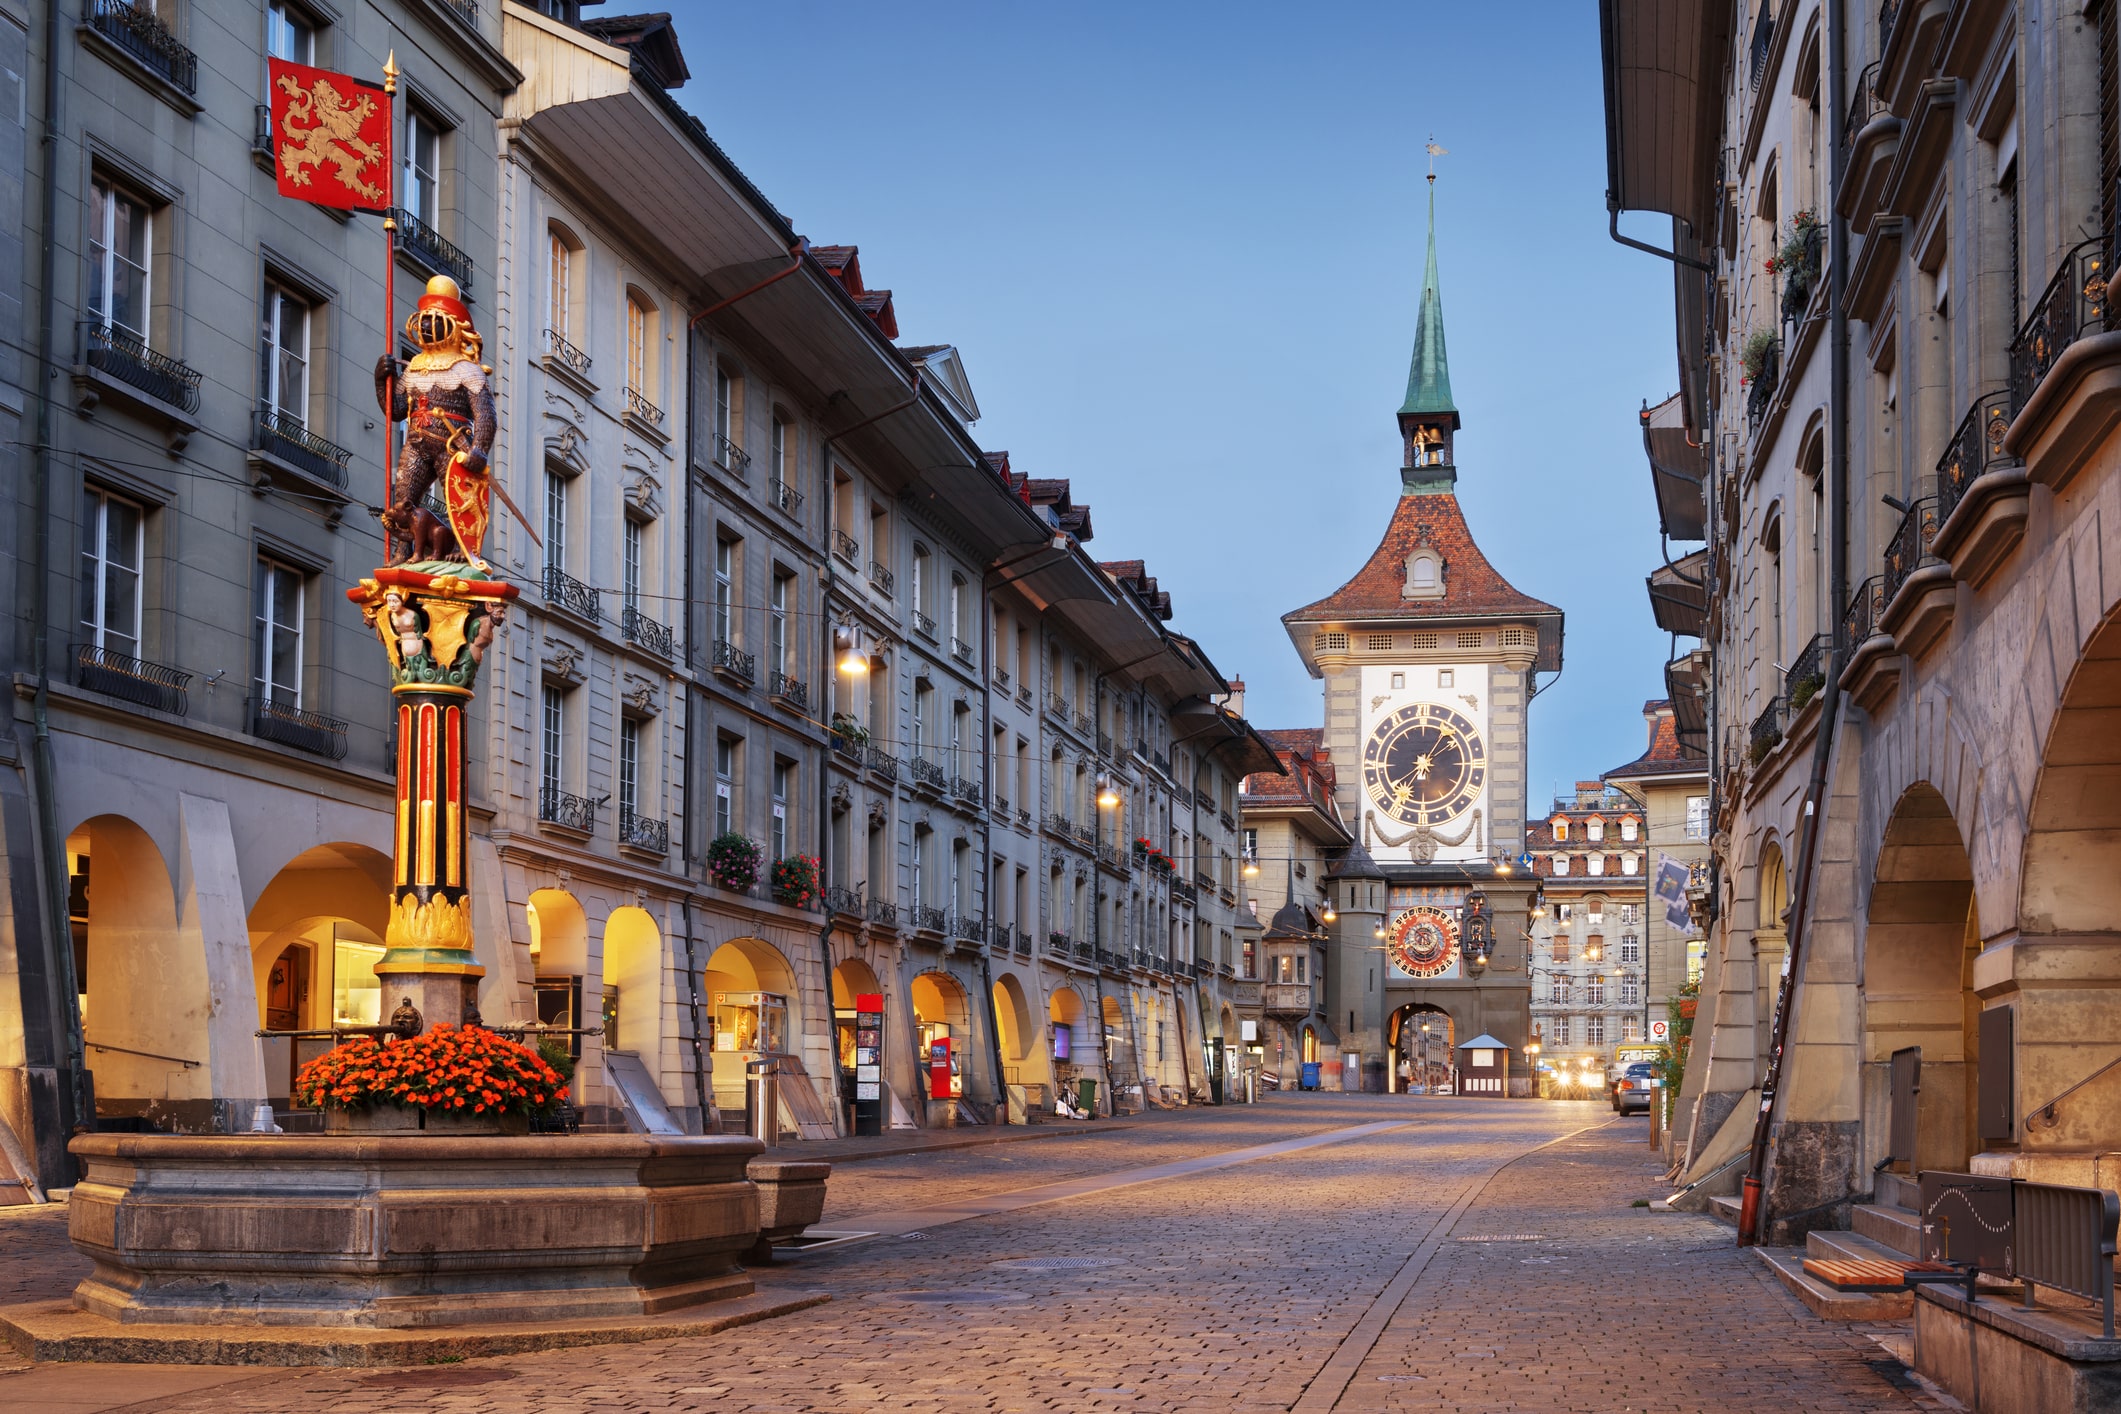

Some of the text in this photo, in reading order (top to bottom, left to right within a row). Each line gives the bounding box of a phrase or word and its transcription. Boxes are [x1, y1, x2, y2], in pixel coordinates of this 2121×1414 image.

[1416, 704, 1430, 717] XII
[1391, 712, 1403, 727] XI
[1447, 711, 1455, 723] I
[1371, 732, 1383, 745] X
[1465, 730, 1478, 742] II
[1364, 759, 1376, 770] IX
[1472, 758, 1486, 769] III
